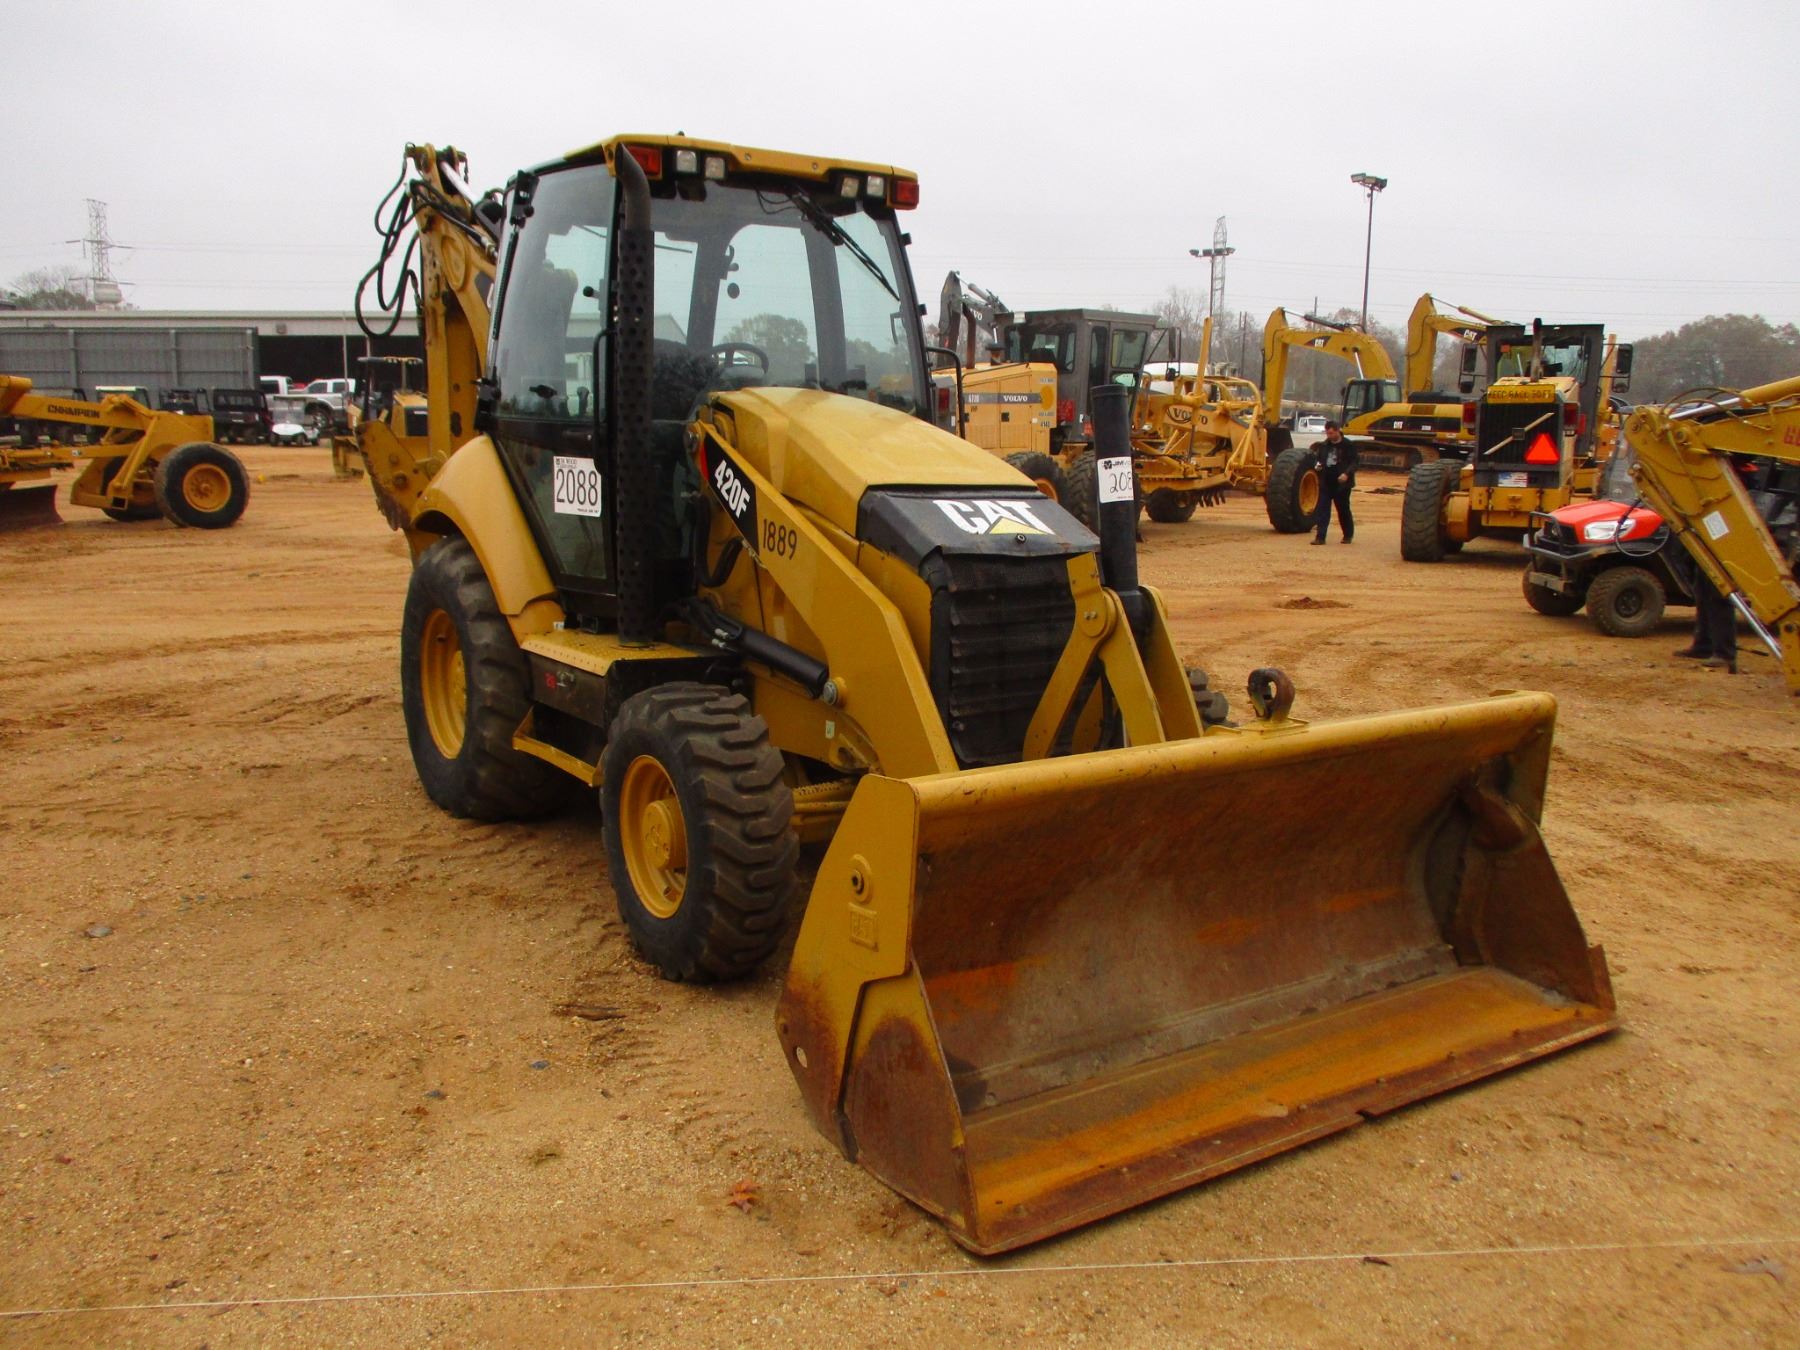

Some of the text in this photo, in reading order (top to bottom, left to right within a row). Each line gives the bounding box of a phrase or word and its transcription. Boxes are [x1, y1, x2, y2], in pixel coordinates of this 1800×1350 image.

[48, 404, 100, 418] CHAMPION
[556, 468, 598, 506] 2088
[714, 459, 751, 519] 420F
[932, 499, 1056, 535] CAT
[762, 518, 797, 560] 1889
